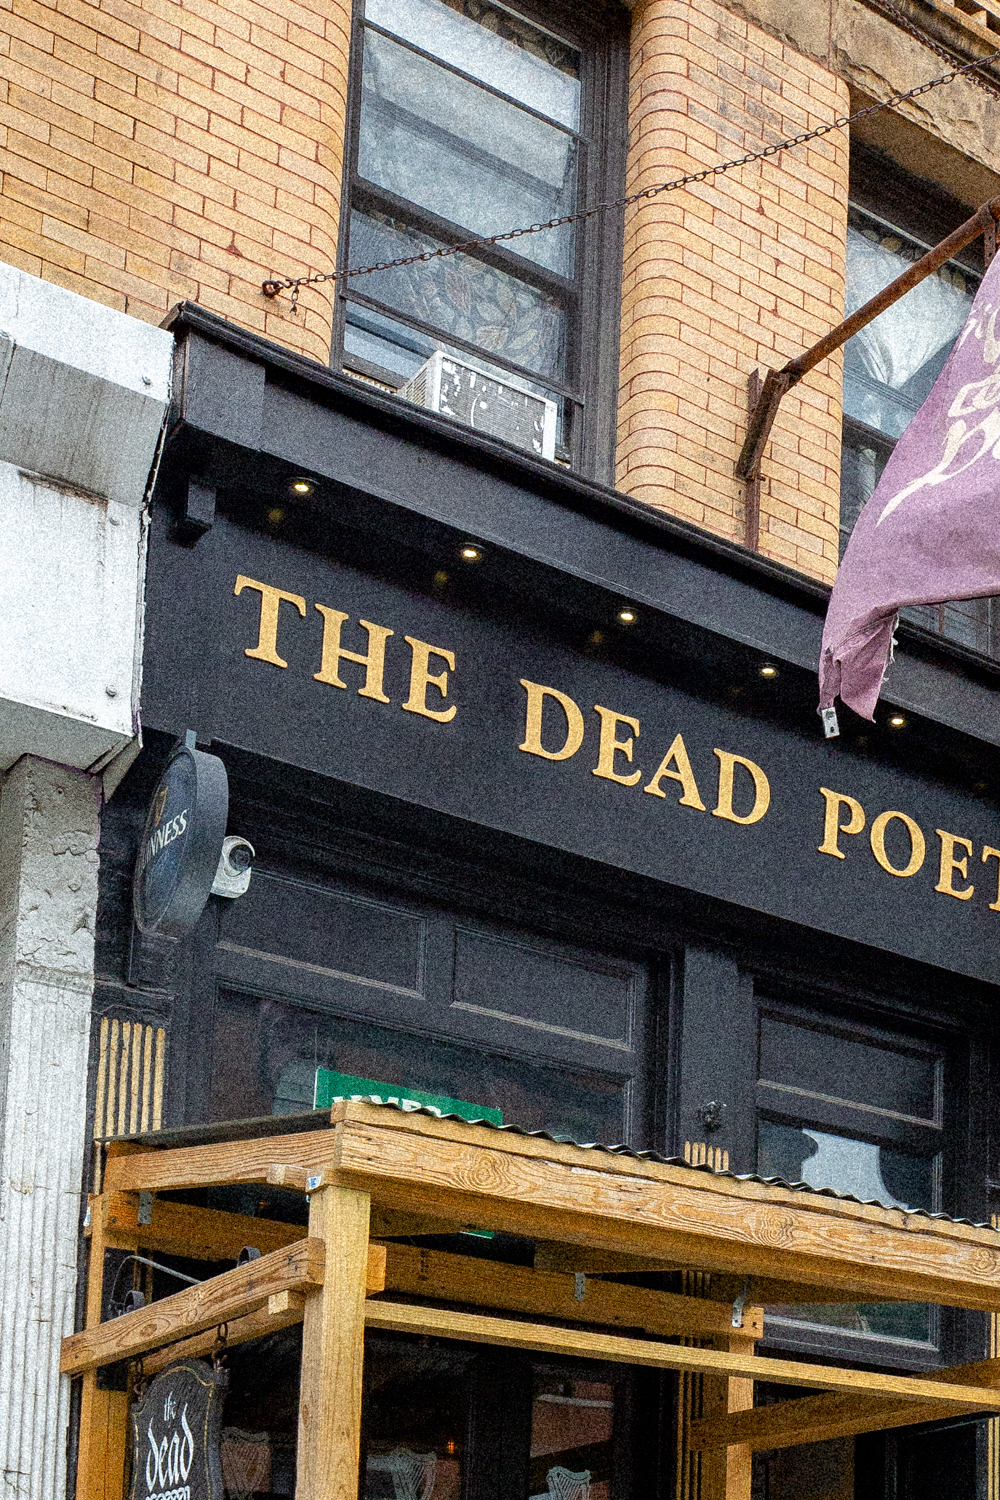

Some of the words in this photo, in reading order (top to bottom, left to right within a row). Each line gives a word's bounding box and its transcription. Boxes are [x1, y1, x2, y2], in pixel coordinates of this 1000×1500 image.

[234, 574, 457, 722] THE
[518, 678, 771, 825] DEAD
[146, 1402, 193, 1492] dead
[164, 1390, 176, 1427] the
